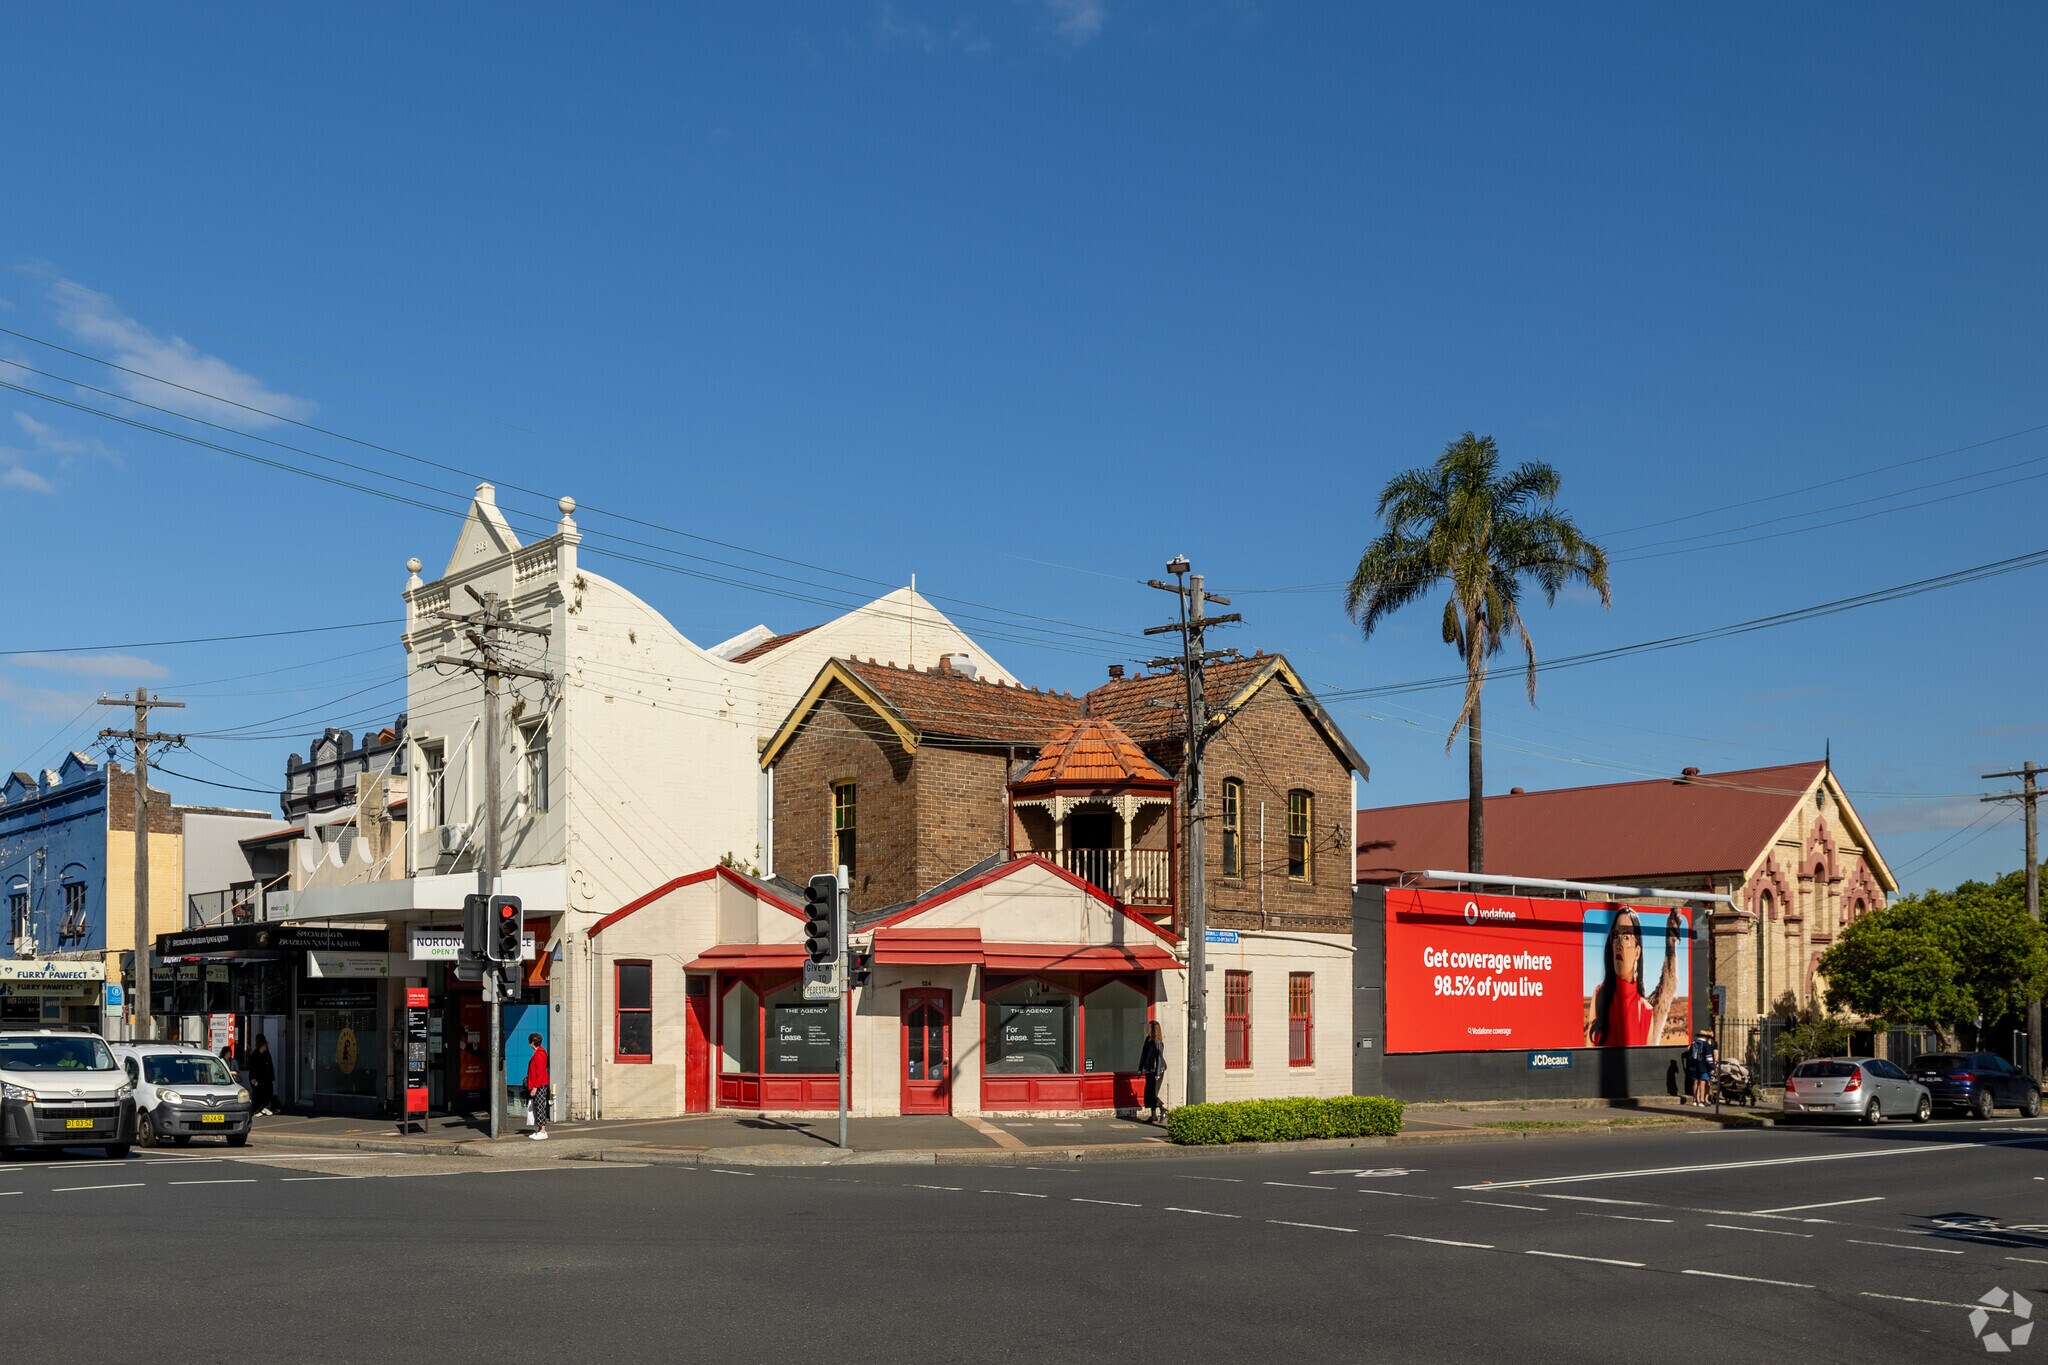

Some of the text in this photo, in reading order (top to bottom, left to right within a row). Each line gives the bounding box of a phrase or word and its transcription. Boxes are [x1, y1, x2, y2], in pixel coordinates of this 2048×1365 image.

[1480, 907, 1516, 921] vodafone
[417, 938, 459, 947] NORTON
[1424, 946, 1552, 974] Get coverage where
[826, 964, 838, 972] WAY
[17, 971, 87, 979] FURRY PAWFECT
[819, 975, 827, 983] TO
[807, 986, 838, 994] PEDESTRIANS
[1434, 975, 1543, 1001] 98.5% of you live
[780, 1025, 793, 1033] For
[1006, 1025, 1019, 1033] For
[1472, 1027, 1512, 1036] Vodafone coverage
[780, 1033, 803, 1041] Lease.
[1006, 1034, 1029, 1042] Lease.
[1532, 1055, 1569, 1066] JCDecaux
